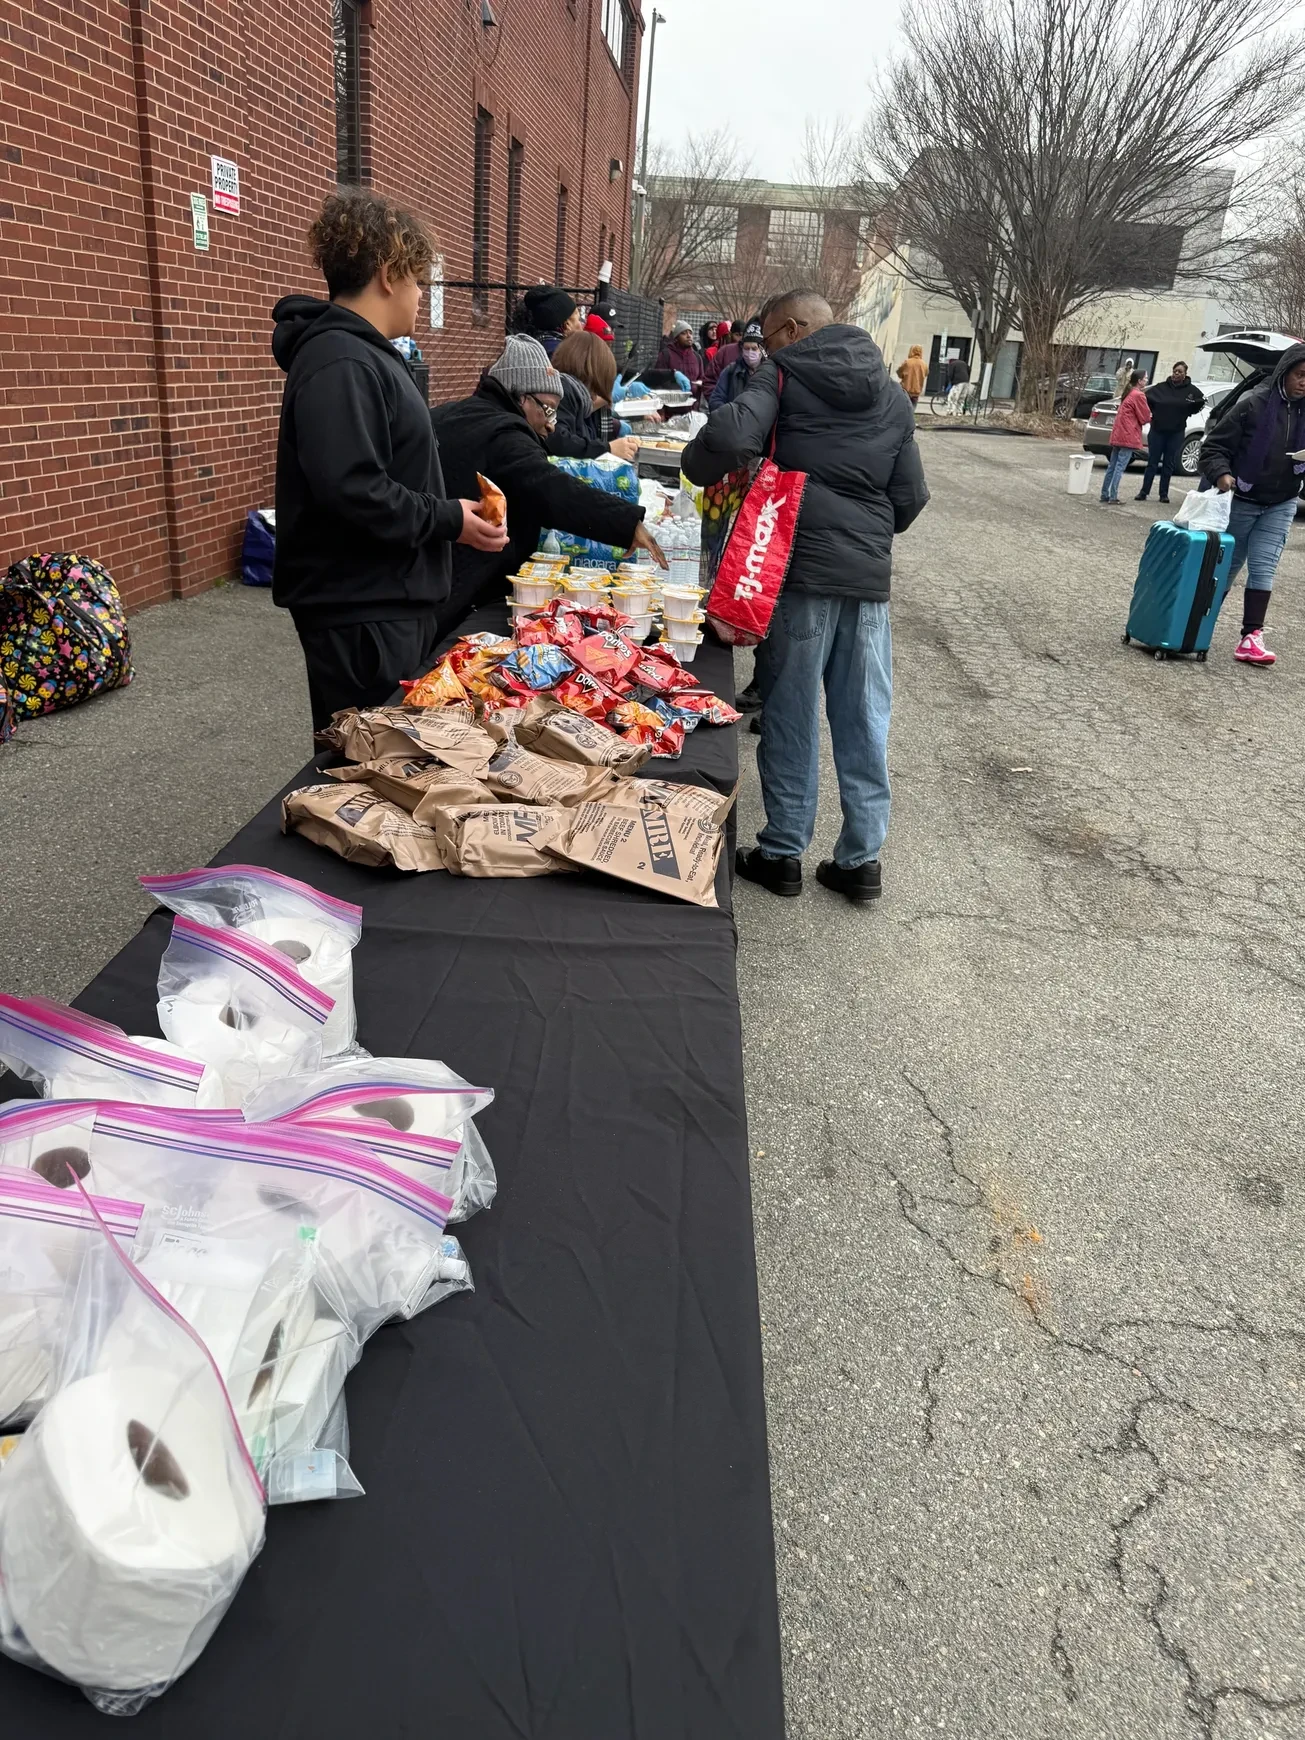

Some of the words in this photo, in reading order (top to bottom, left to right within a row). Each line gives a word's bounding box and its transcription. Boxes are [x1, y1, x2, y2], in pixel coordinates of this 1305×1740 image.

[216, 163, 237, 181] PRIVATE
[600, 630, 632, 658] Doritos
[620, 818, 628, 831] BEEF
[624, 820, 636, 837] MENU
[643, 808, 674, 862] MRE
[601, 832, 621, 863] SHREDDED,
[637, 861, 646, 870] 2
